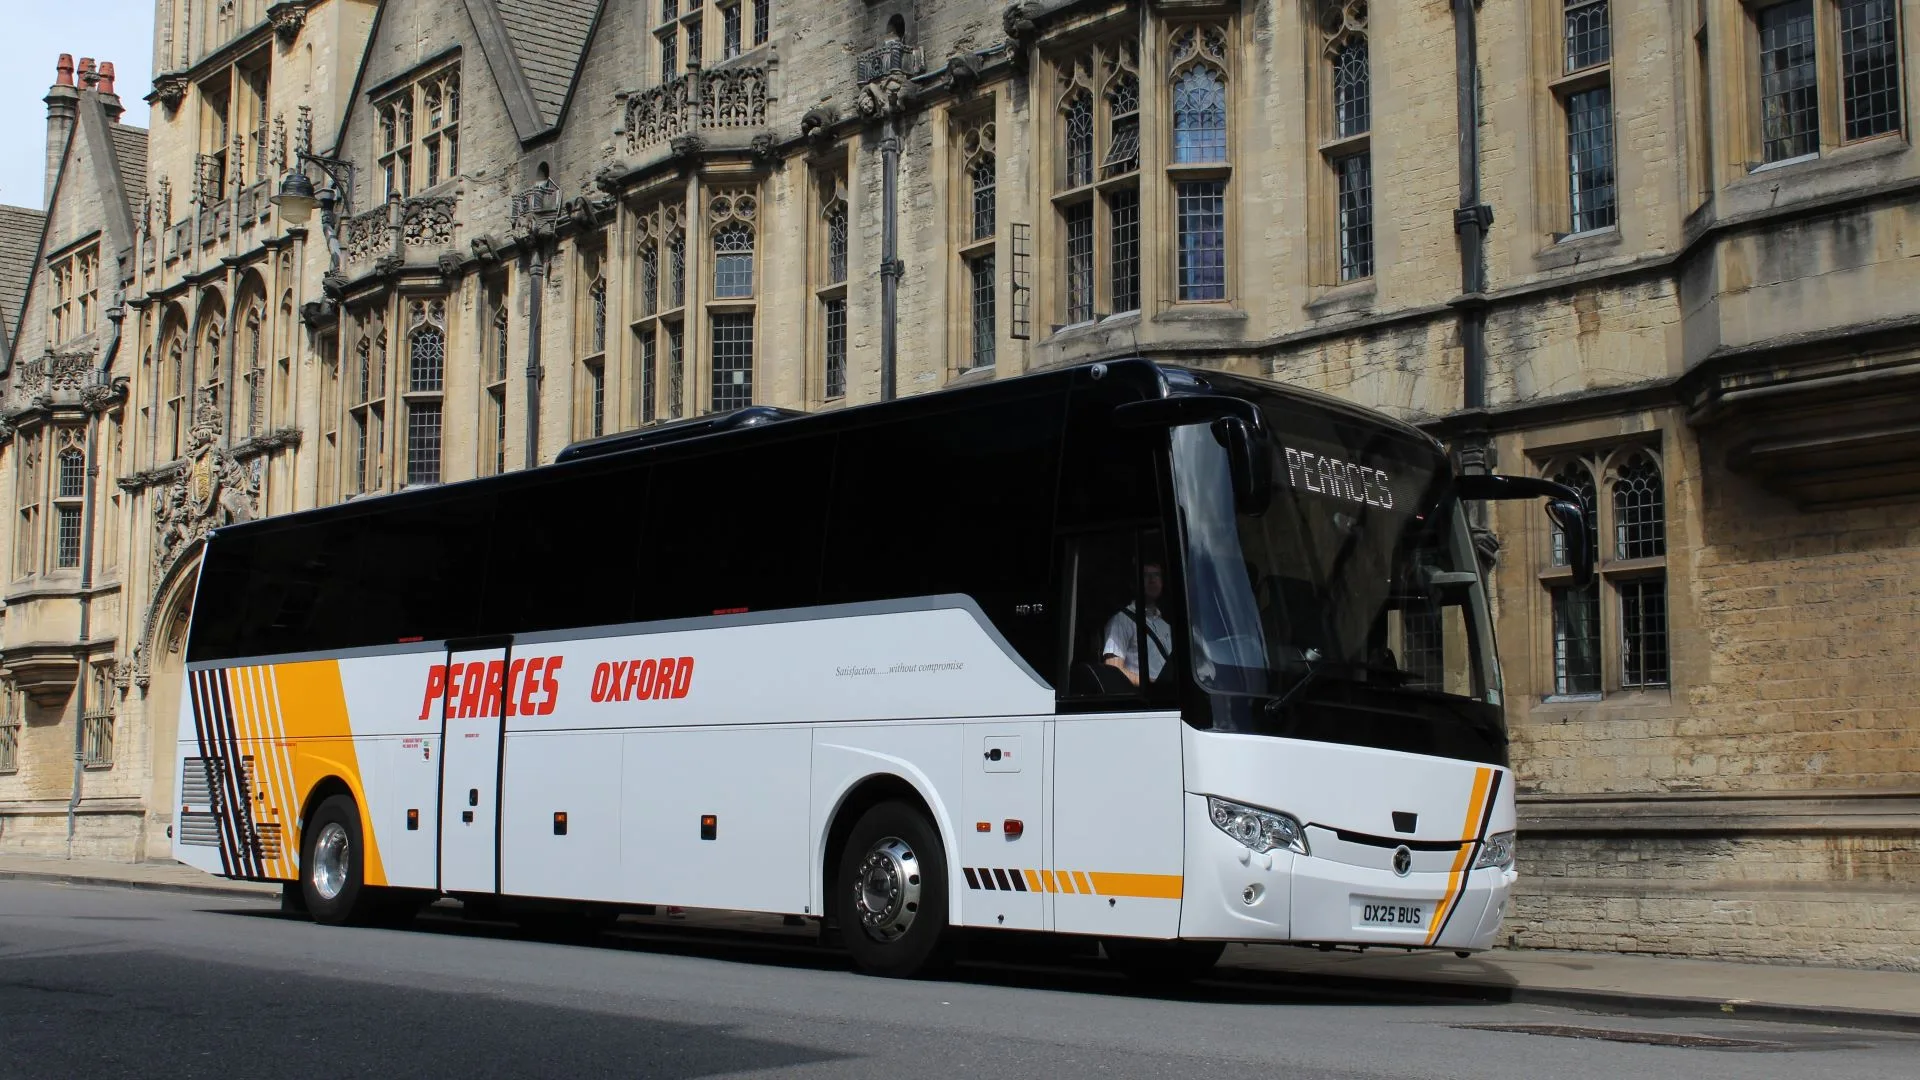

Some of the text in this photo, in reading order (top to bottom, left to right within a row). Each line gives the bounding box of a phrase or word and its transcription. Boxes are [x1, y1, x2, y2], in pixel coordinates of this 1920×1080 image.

[1285, 447, 1392, 509] PEARCES
[918, 660, 964, 675] compromise
[419, 656, 694, 720] PEARCES OXFORD
[1364, 905, 1421, 924] OX25 BUS
